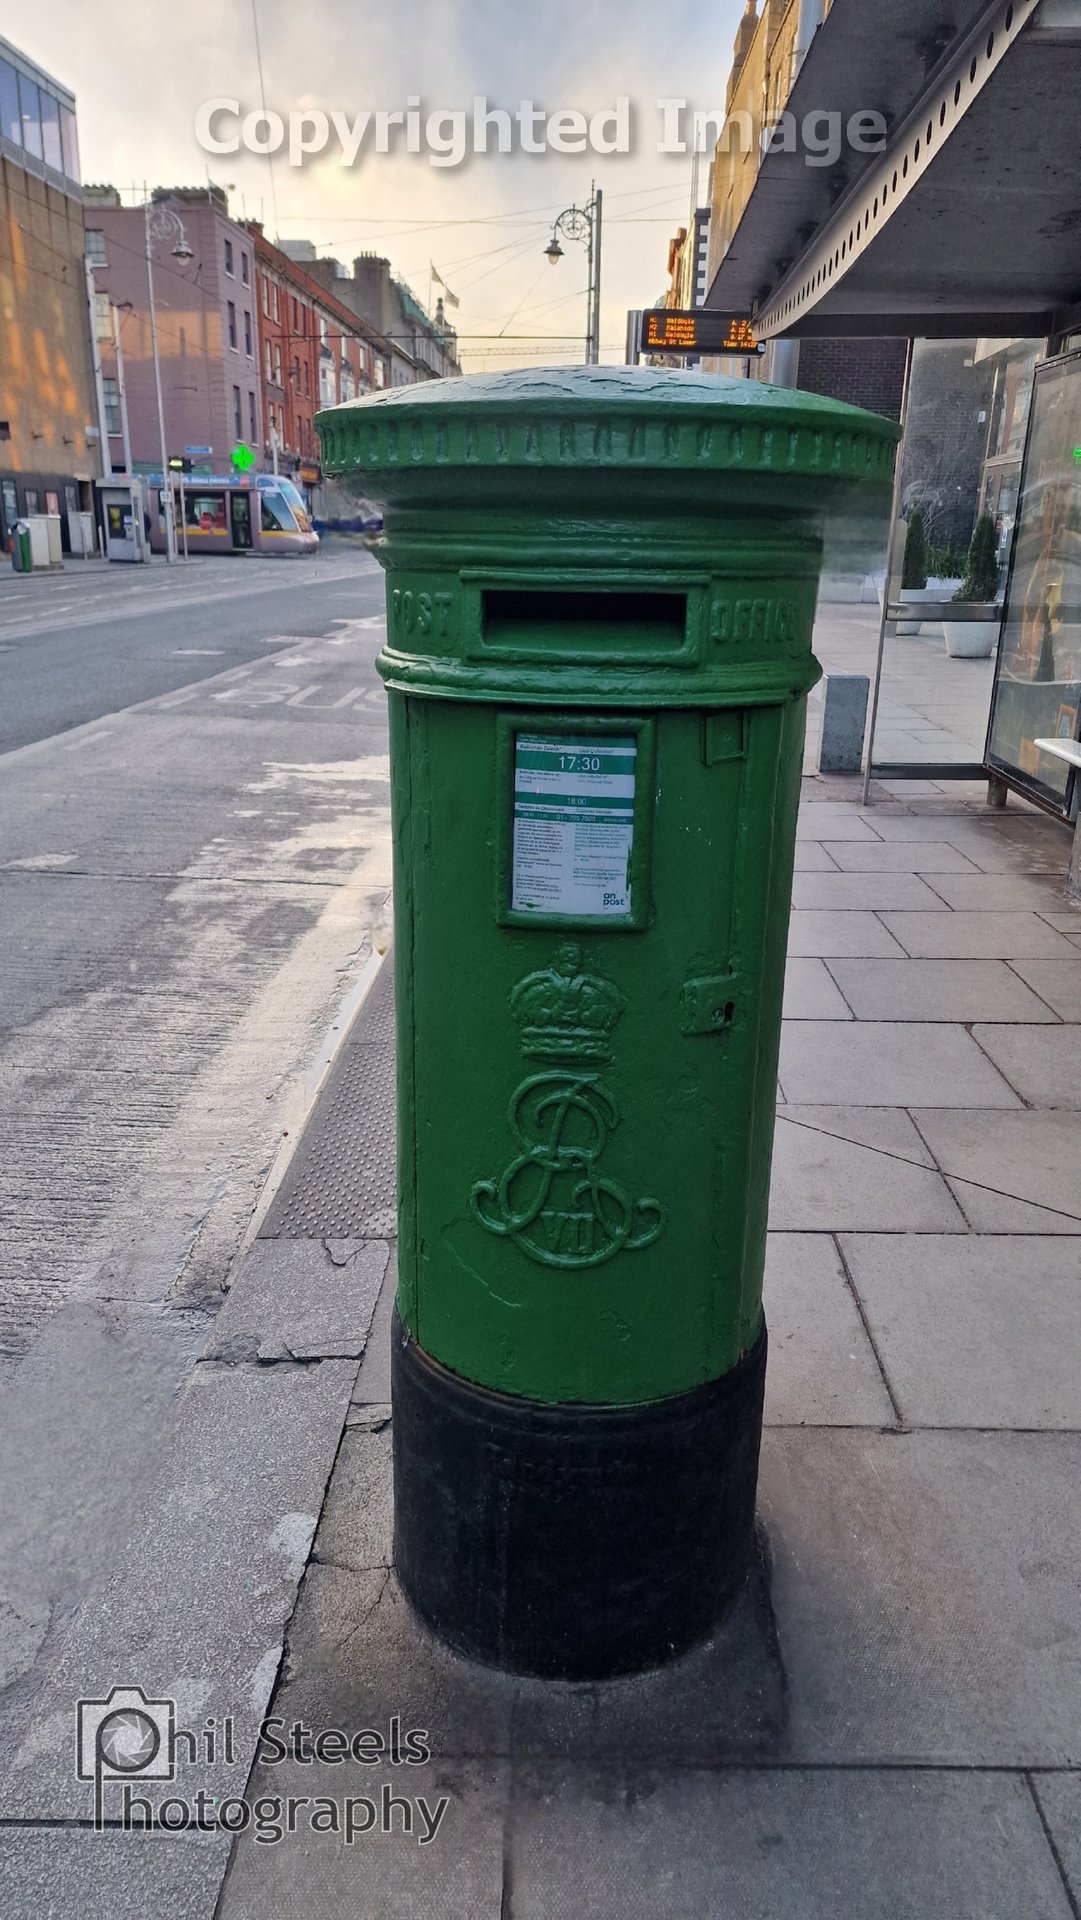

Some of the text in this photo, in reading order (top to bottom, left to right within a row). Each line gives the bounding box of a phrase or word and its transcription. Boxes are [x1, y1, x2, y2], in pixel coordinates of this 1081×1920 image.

[666, 317, 695, 325] Baldoyle
[666, 331, 694, 339] Baldoyle
[392, 589, 454, 635] POST
[559, 756, 600, 770] 17:30
[567, 797, 587, 806] 18:00
[603, 898, 625, 906] post
